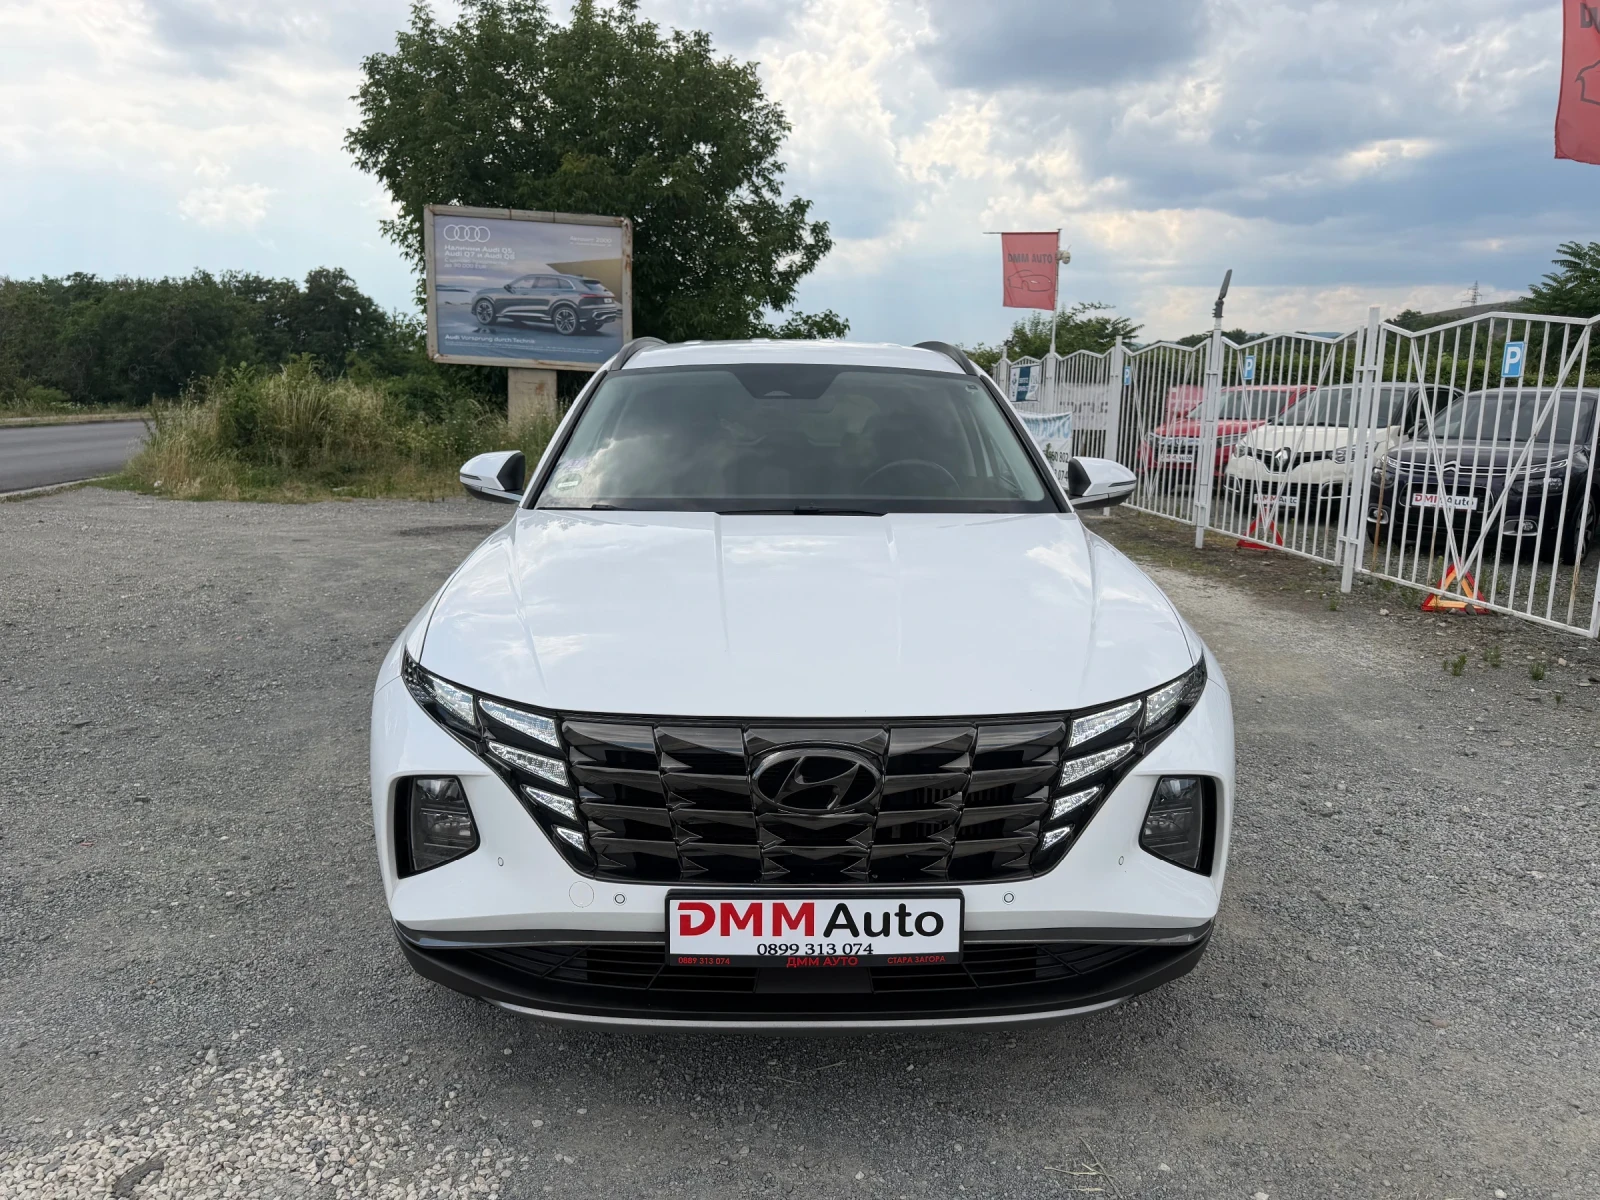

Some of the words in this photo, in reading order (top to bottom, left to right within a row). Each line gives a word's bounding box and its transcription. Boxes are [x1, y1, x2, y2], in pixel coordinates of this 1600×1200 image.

[1007, 253, 1029, 263] DMM
[1031, 253, 1053, 264] AUTO
[1504, 346, 1521, 374] P
[677, 902, 815, 937] DMM
[823, 902, 944, 938] Auto
[756, 943, 800, 956] 0899
[805, 943, 837, 956] 313
[842, 943, 874, 956] 074
[699, 957, 714, 965] 313
[715, 957, 731, 965] 074
[786, 956, 820, 968] ДММ
[823, 956, 859, 967] АУТО
[887, 956, 914, 964] СТАРА
[915, 955, 946, 963] ЗАГОРА
